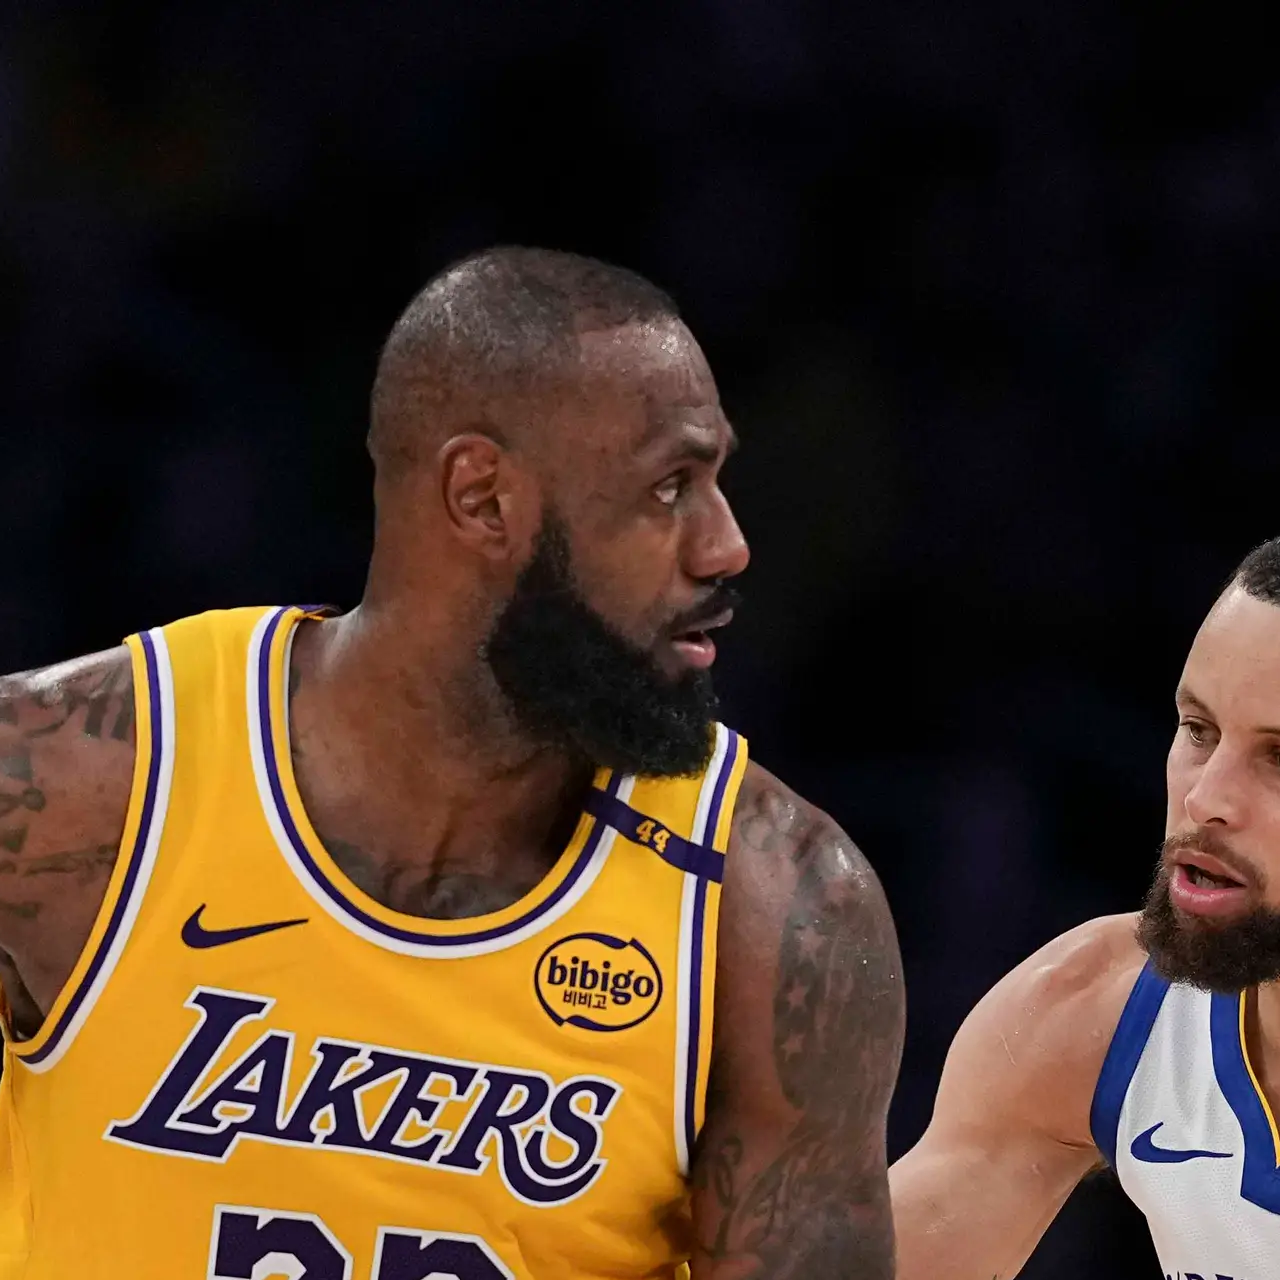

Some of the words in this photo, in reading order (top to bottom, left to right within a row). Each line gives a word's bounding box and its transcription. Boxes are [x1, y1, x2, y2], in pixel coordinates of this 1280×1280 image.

[636, 819, 671, 854] 44
[547, 955, 654, 1005] bibigo
[562, 989, 607, 1010] 비비고
[103, 985, 624, 1207] LAKERS
